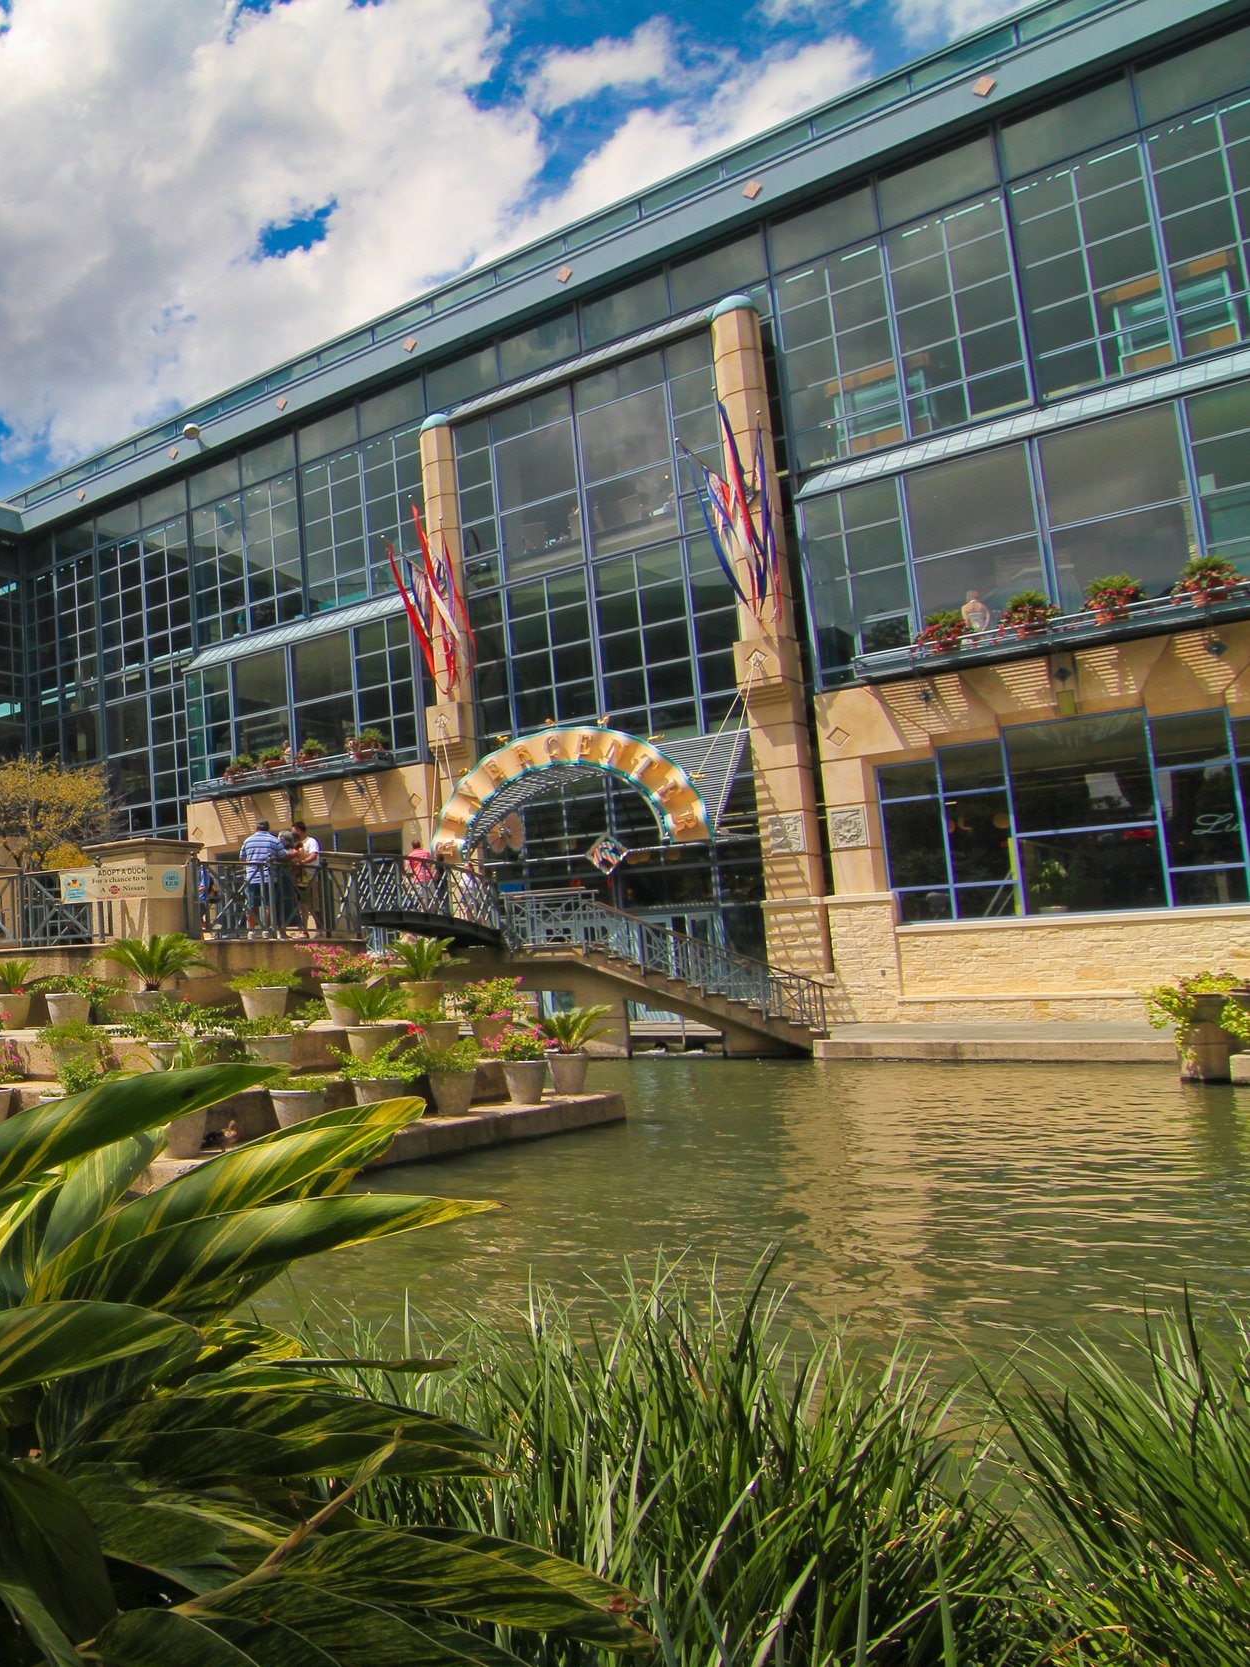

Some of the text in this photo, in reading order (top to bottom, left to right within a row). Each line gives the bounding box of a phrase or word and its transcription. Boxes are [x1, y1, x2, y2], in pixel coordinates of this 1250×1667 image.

[435, 734, 698, 857] RIVERCENTER
[97, 868, 120, 877] ADOPT
[127, 867, 146, 875] DUCK
